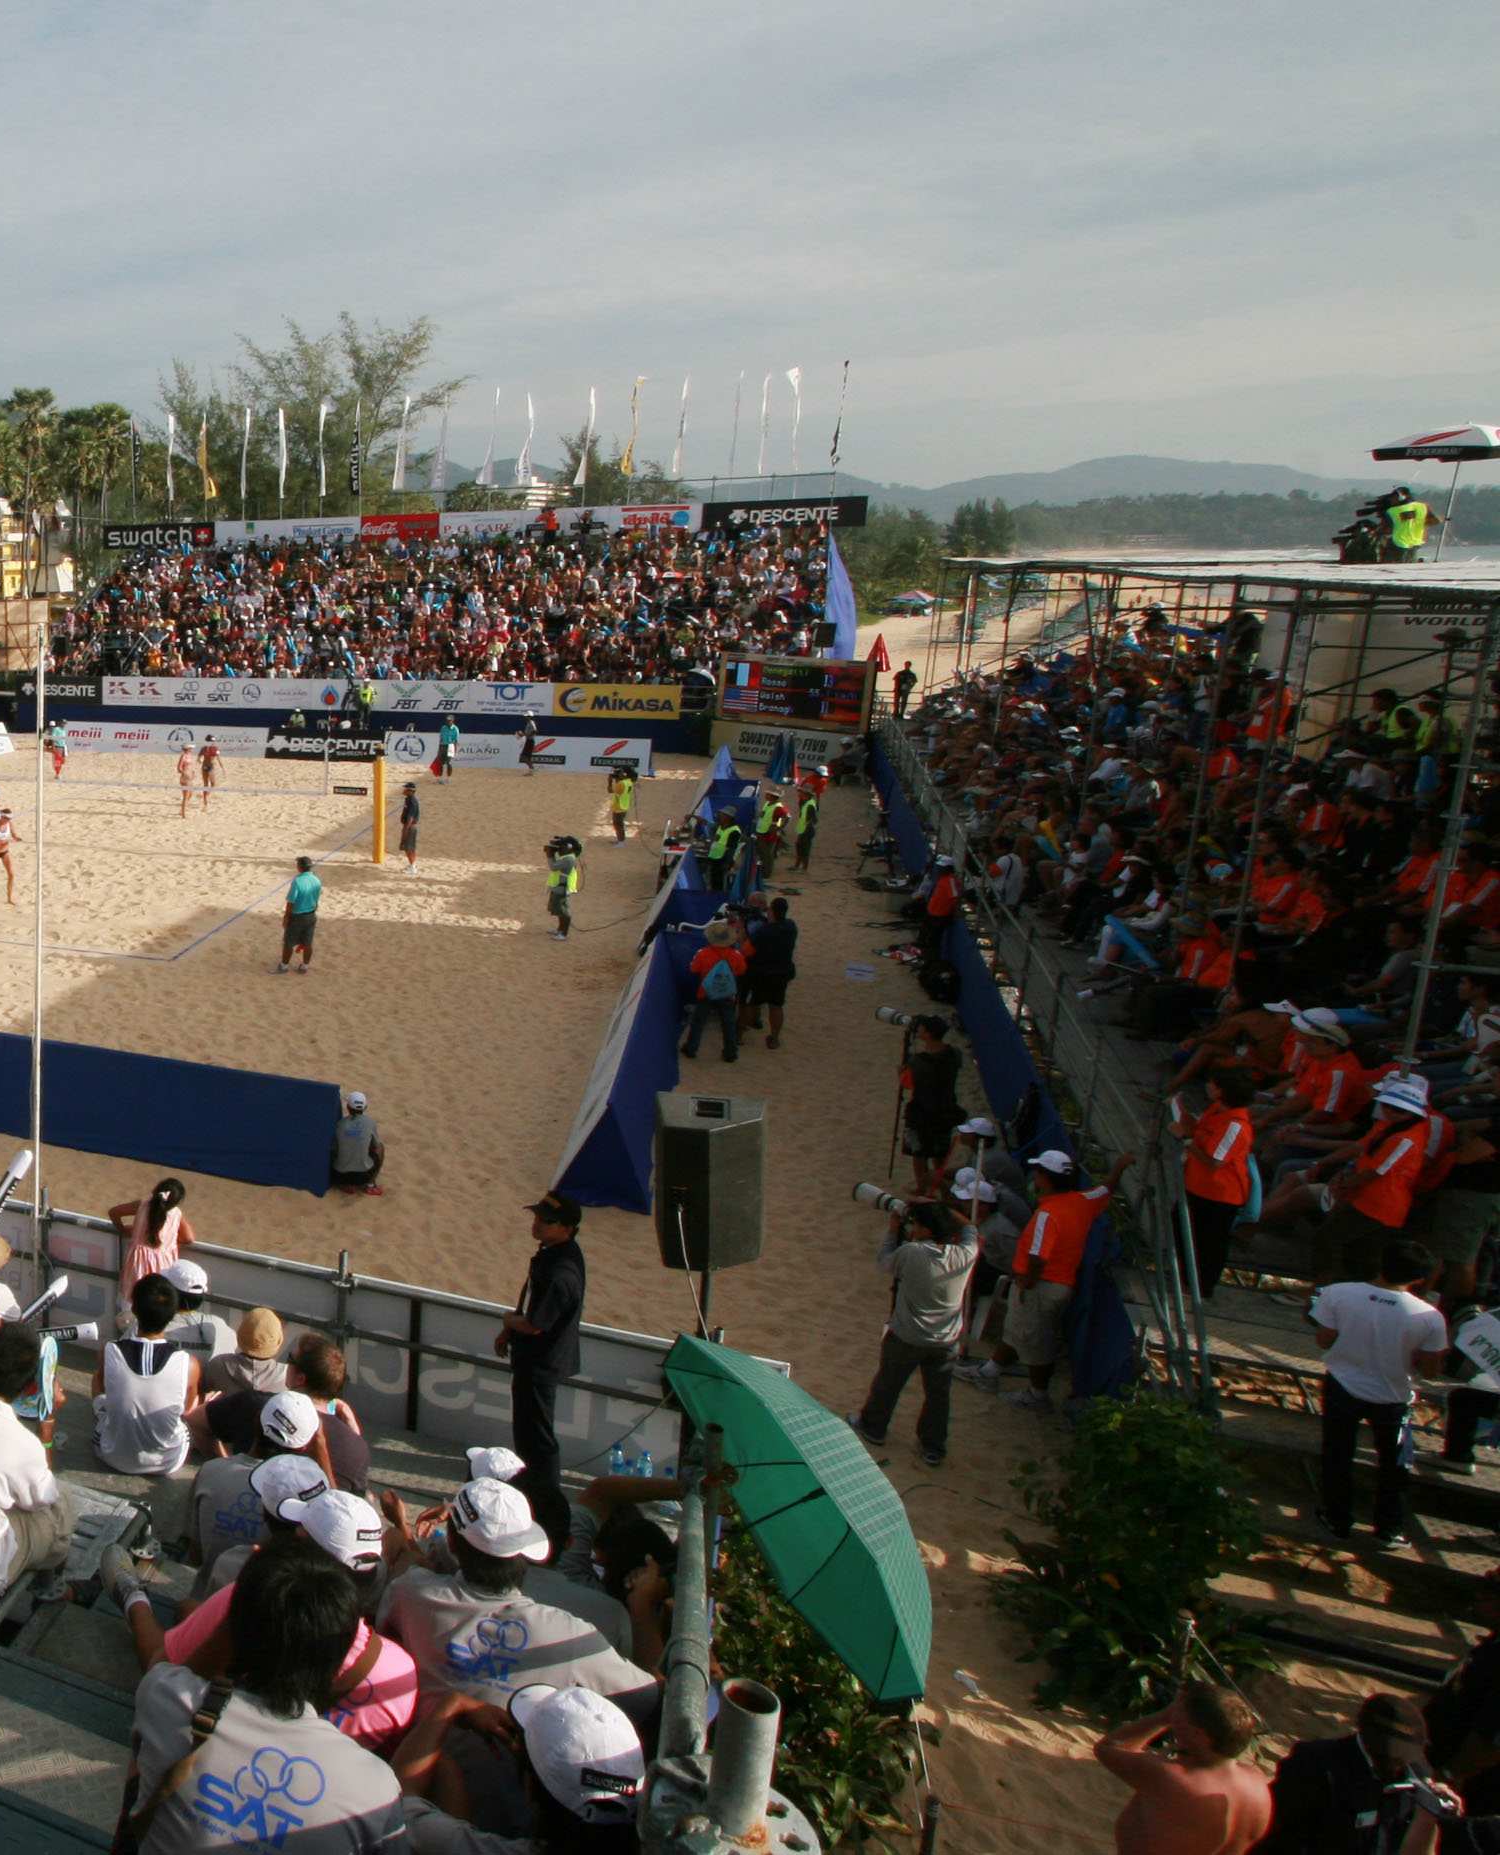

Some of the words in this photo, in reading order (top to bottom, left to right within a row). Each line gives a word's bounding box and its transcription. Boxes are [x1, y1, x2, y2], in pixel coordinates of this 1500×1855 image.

[750, 507, 839, 523] DESCENTE
[107, 526, 193, 547] swatch
[1403, 616, 1487, 626] WORLD
[36, 683, 96, 697] ESCENTE
[174, 692, 197, 701] SAT
[207, 693, 230, 702] SAT
[487, 684, 534, 700] TOT
[391, 700, 422, 710] FBT
[433, 700, 464, 710] FBT
[68, 727, 102, 739] meiji
[114, 729, 150, 741] meiji
[739, 731, 778, 746] SWATC
[290, 737, 382, 754] DESCENTE
[797, 752, 826, 763] OUR
[446, 1641, 520, 1682] SAT
[194, 1772, 304, 1850] SAT
